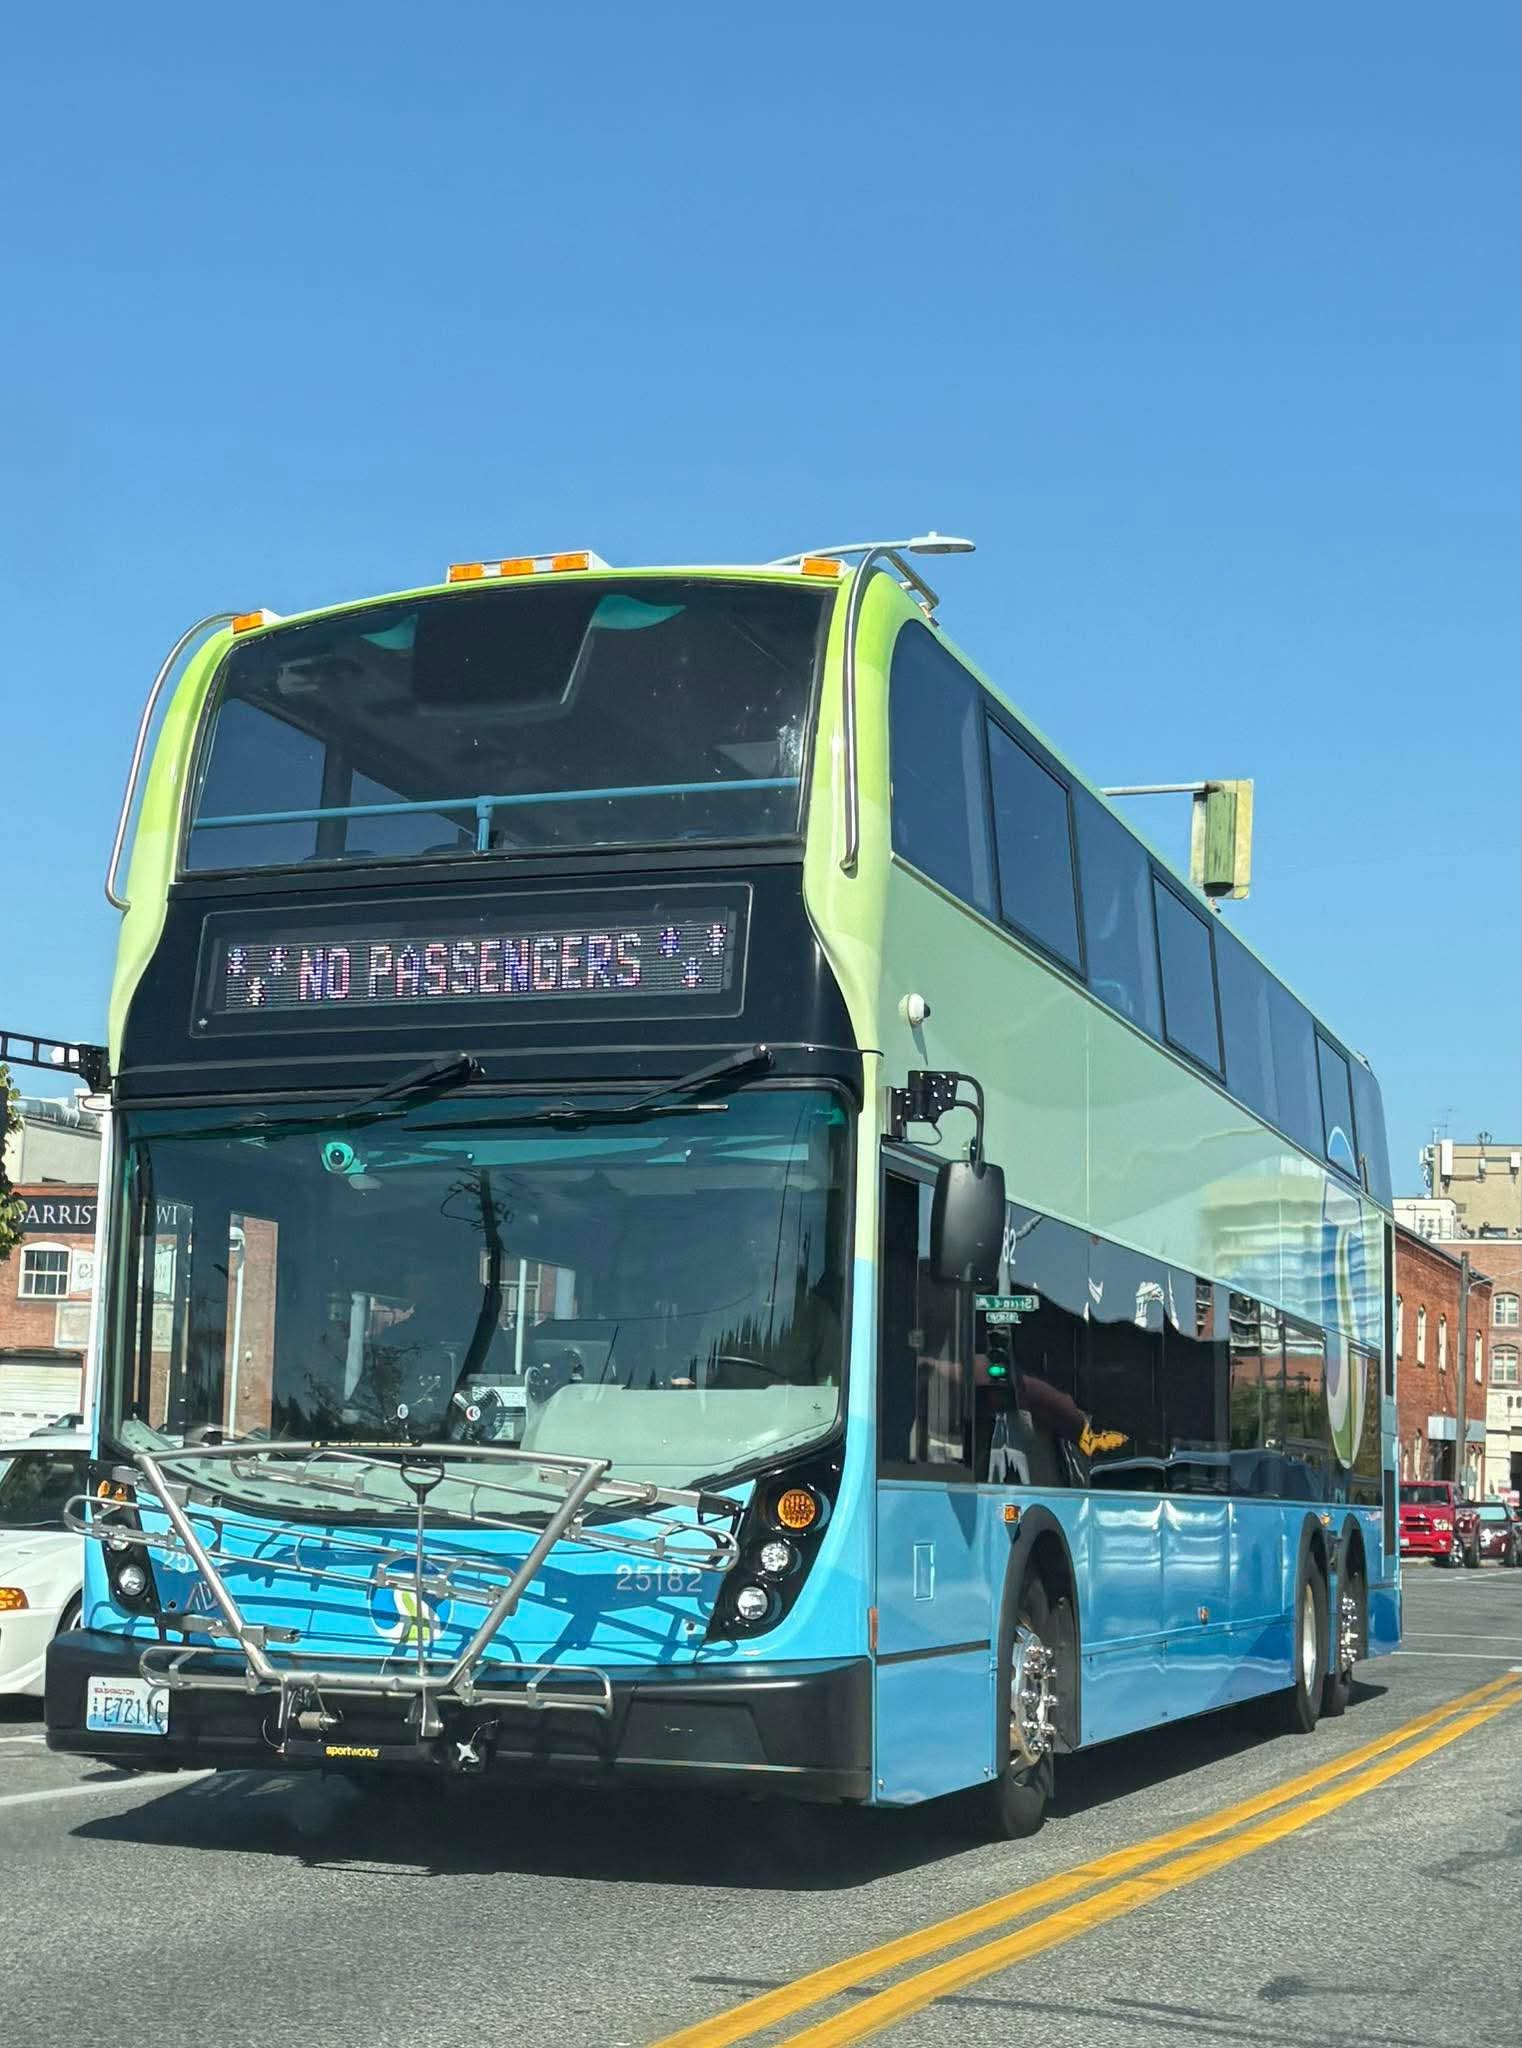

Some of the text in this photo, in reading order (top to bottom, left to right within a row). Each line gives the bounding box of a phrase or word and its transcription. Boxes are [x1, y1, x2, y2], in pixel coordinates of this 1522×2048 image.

[299, 933, 641, 999] NO PASSENGERS
[616, 1564, 702, 1592] 25182
[326, 1746, 379, 1758] sportworks
